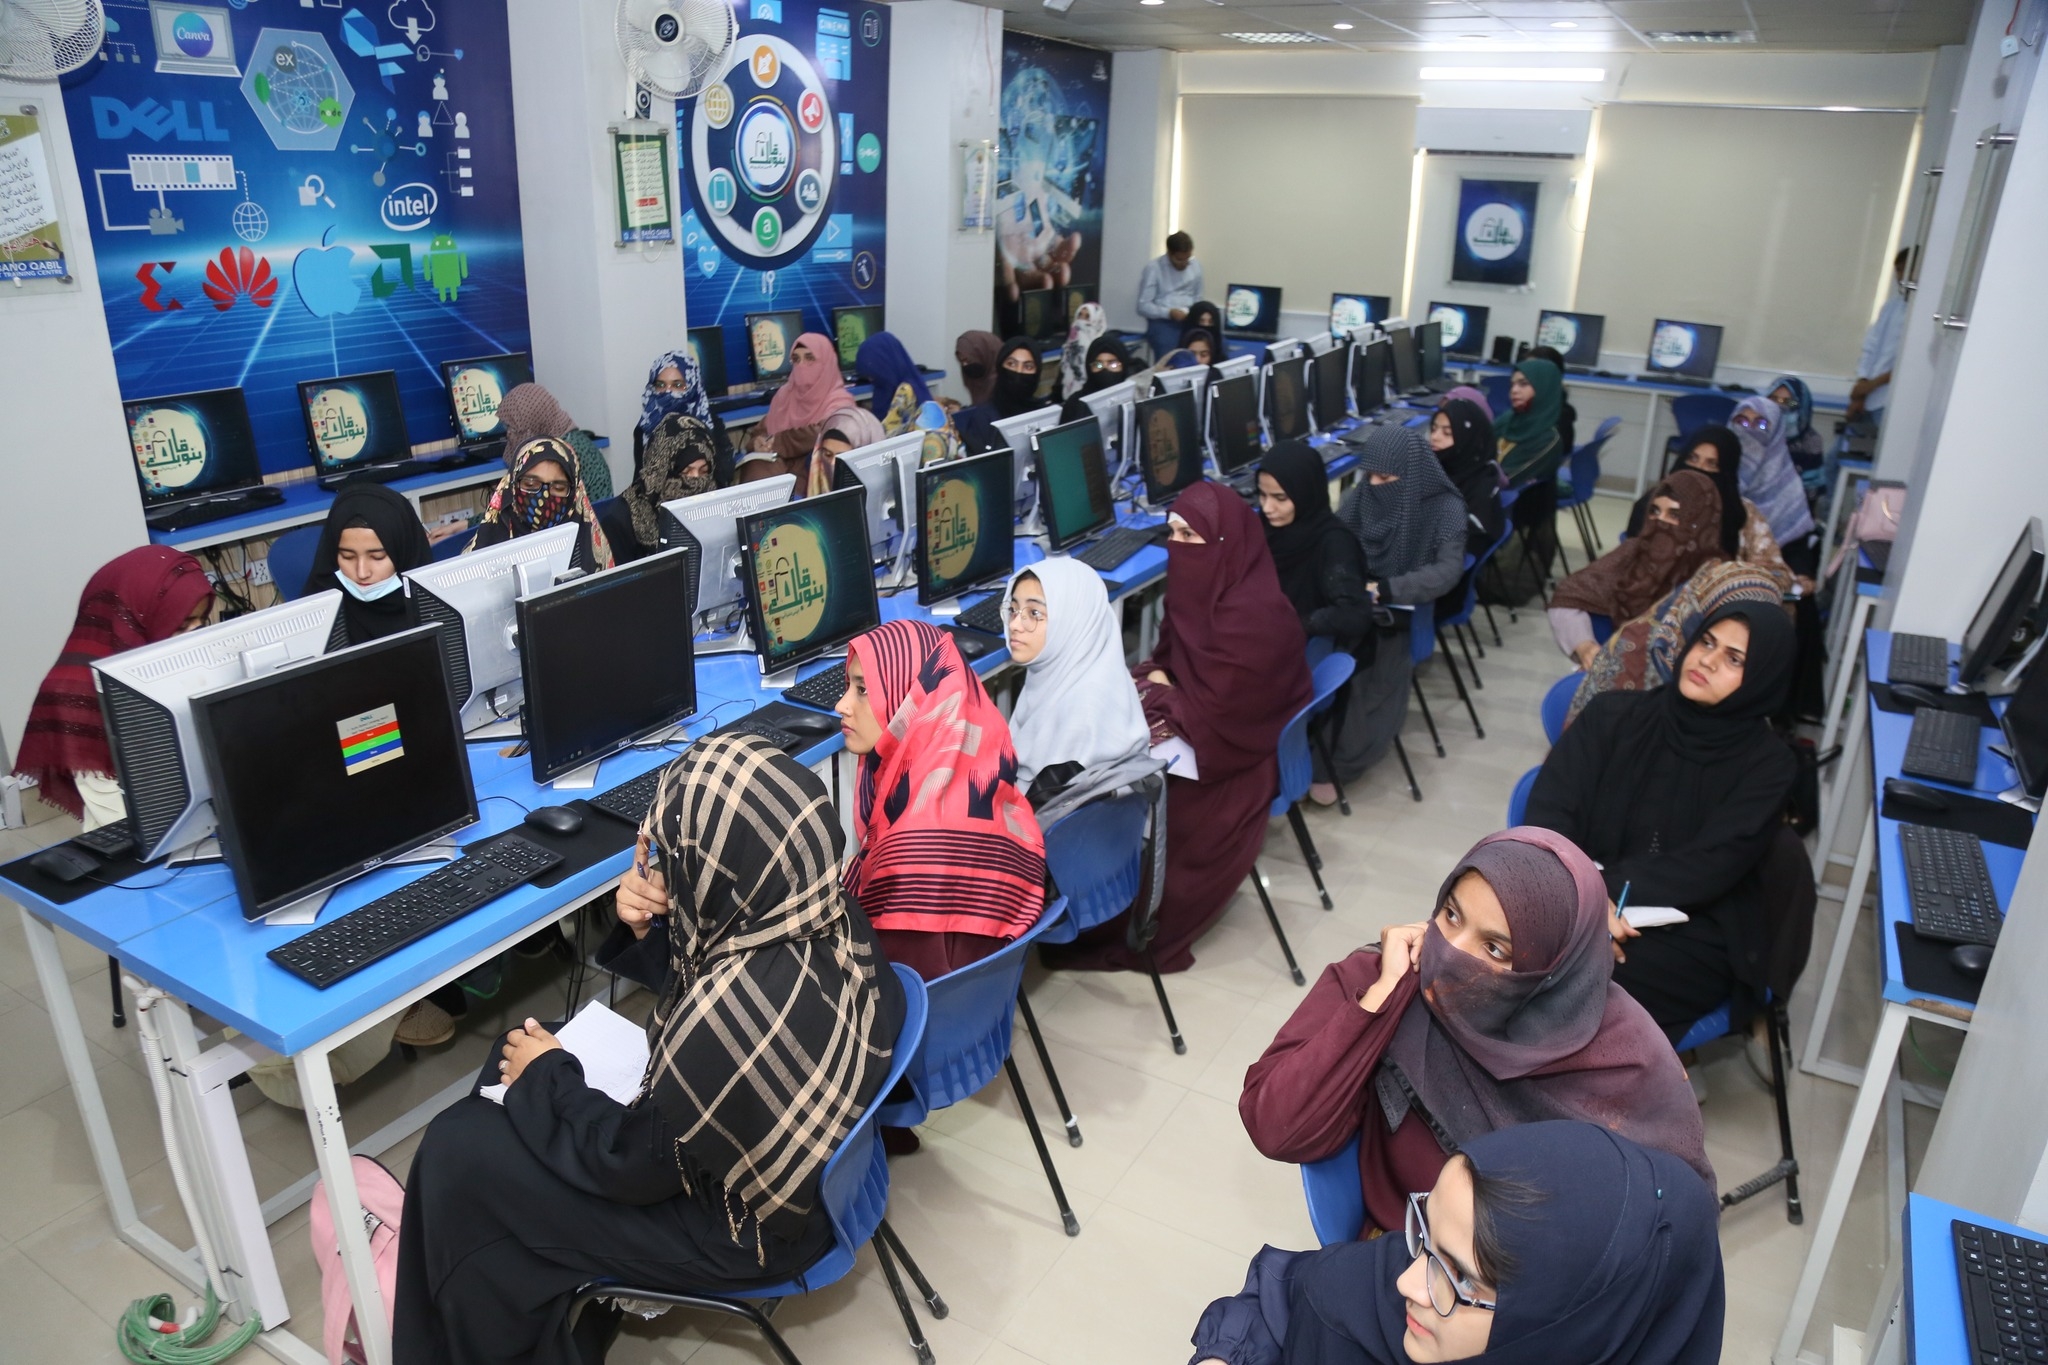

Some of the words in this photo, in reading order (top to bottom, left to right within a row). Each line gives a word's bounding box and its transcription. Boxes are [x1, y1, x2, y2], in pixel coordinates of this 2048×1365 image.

[176, 26, 211, 42] Canva
[275, 53, 295, 67] ex
[90, 96, 230, 142] DELL
[388, 193, 429, 217] intel
[29, 261, 62, 270] QABIL
